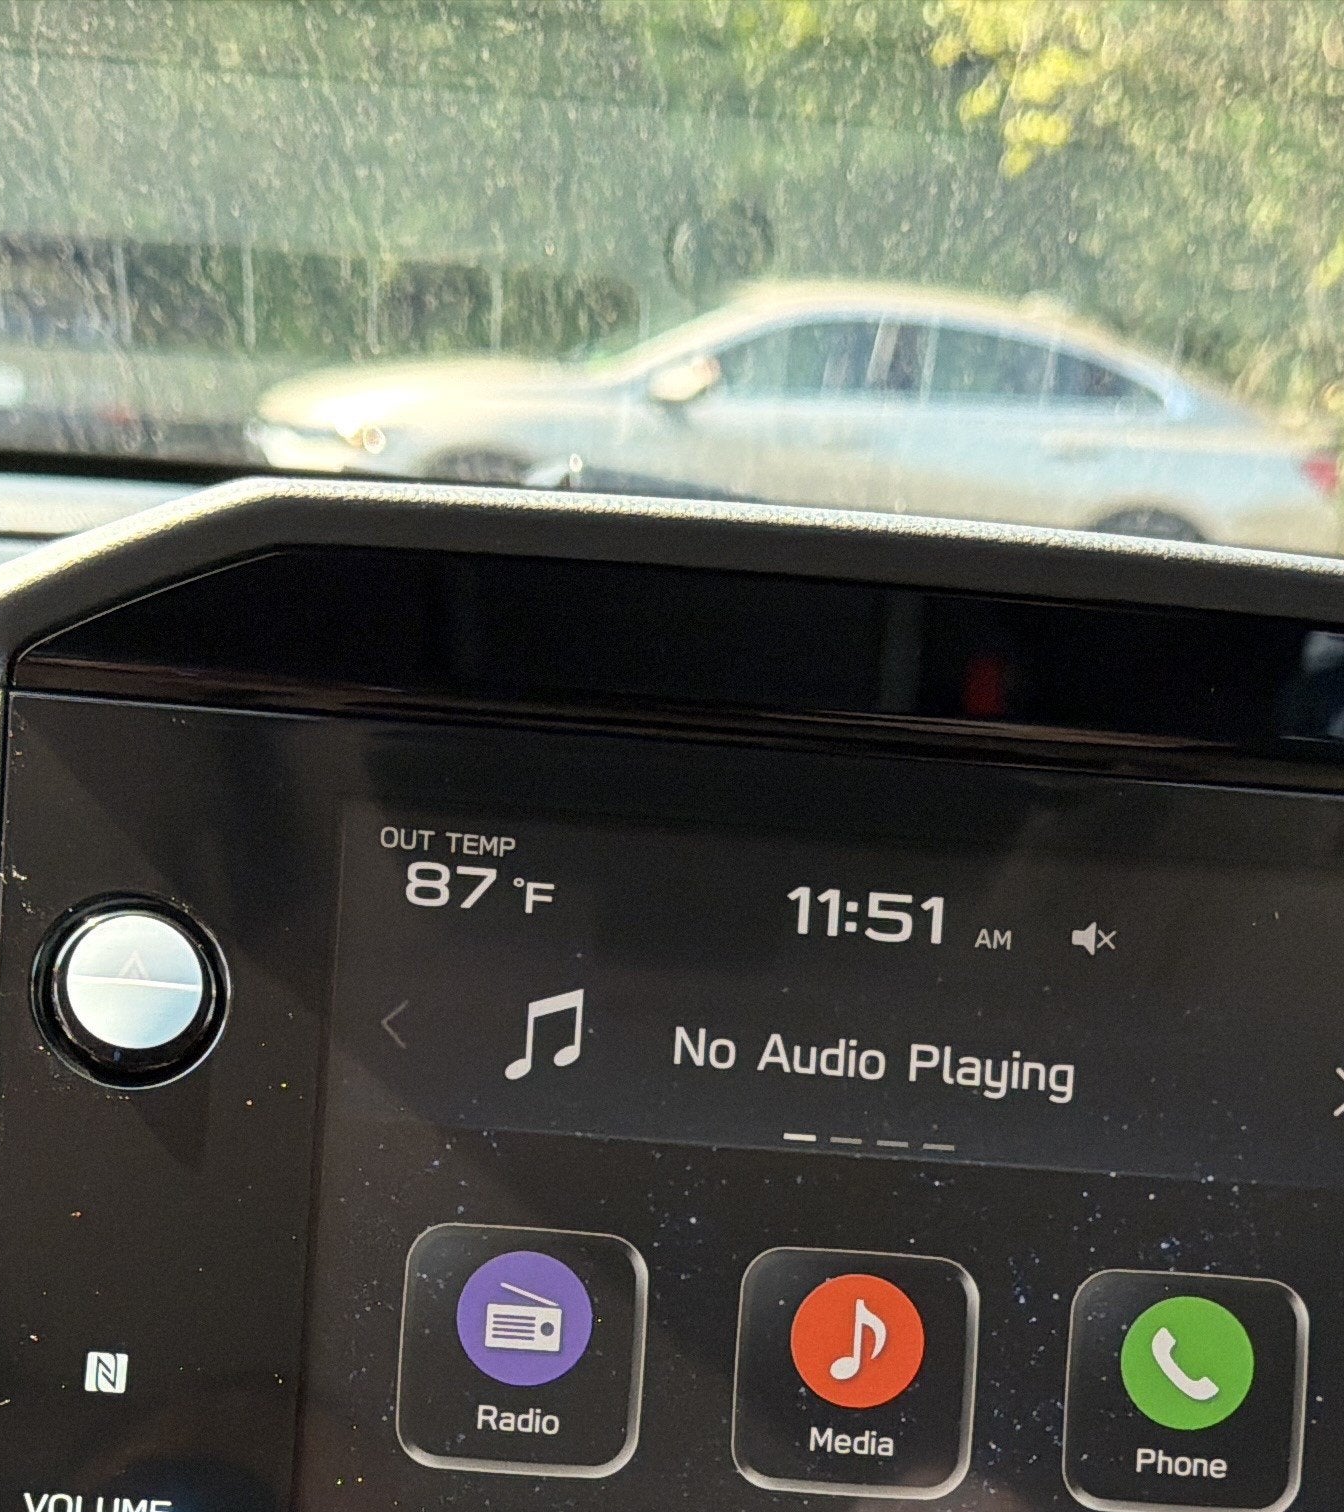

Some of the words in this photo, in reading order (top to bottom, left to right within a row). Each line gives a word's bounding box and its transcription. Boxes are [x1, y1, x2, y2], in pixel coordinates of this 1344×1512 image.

[380, 826, 436, 851] OUT
[445, 831, 516, 858] TEMP
[405, 861, 498, 909] 87
[787, 886, 945, 945] 11:51
[974, 928, 1012, 951] AM
[673, 1026, 736, 1070] No
[756, 1033, 886, 1081] Audio
[908, 1043, 1075, 1104] Playing
[476, 1404, 560, 1435] Radio
[809, 1426, 895, 1457] Media
[1135, 1447, 1228, 1479] Phone
